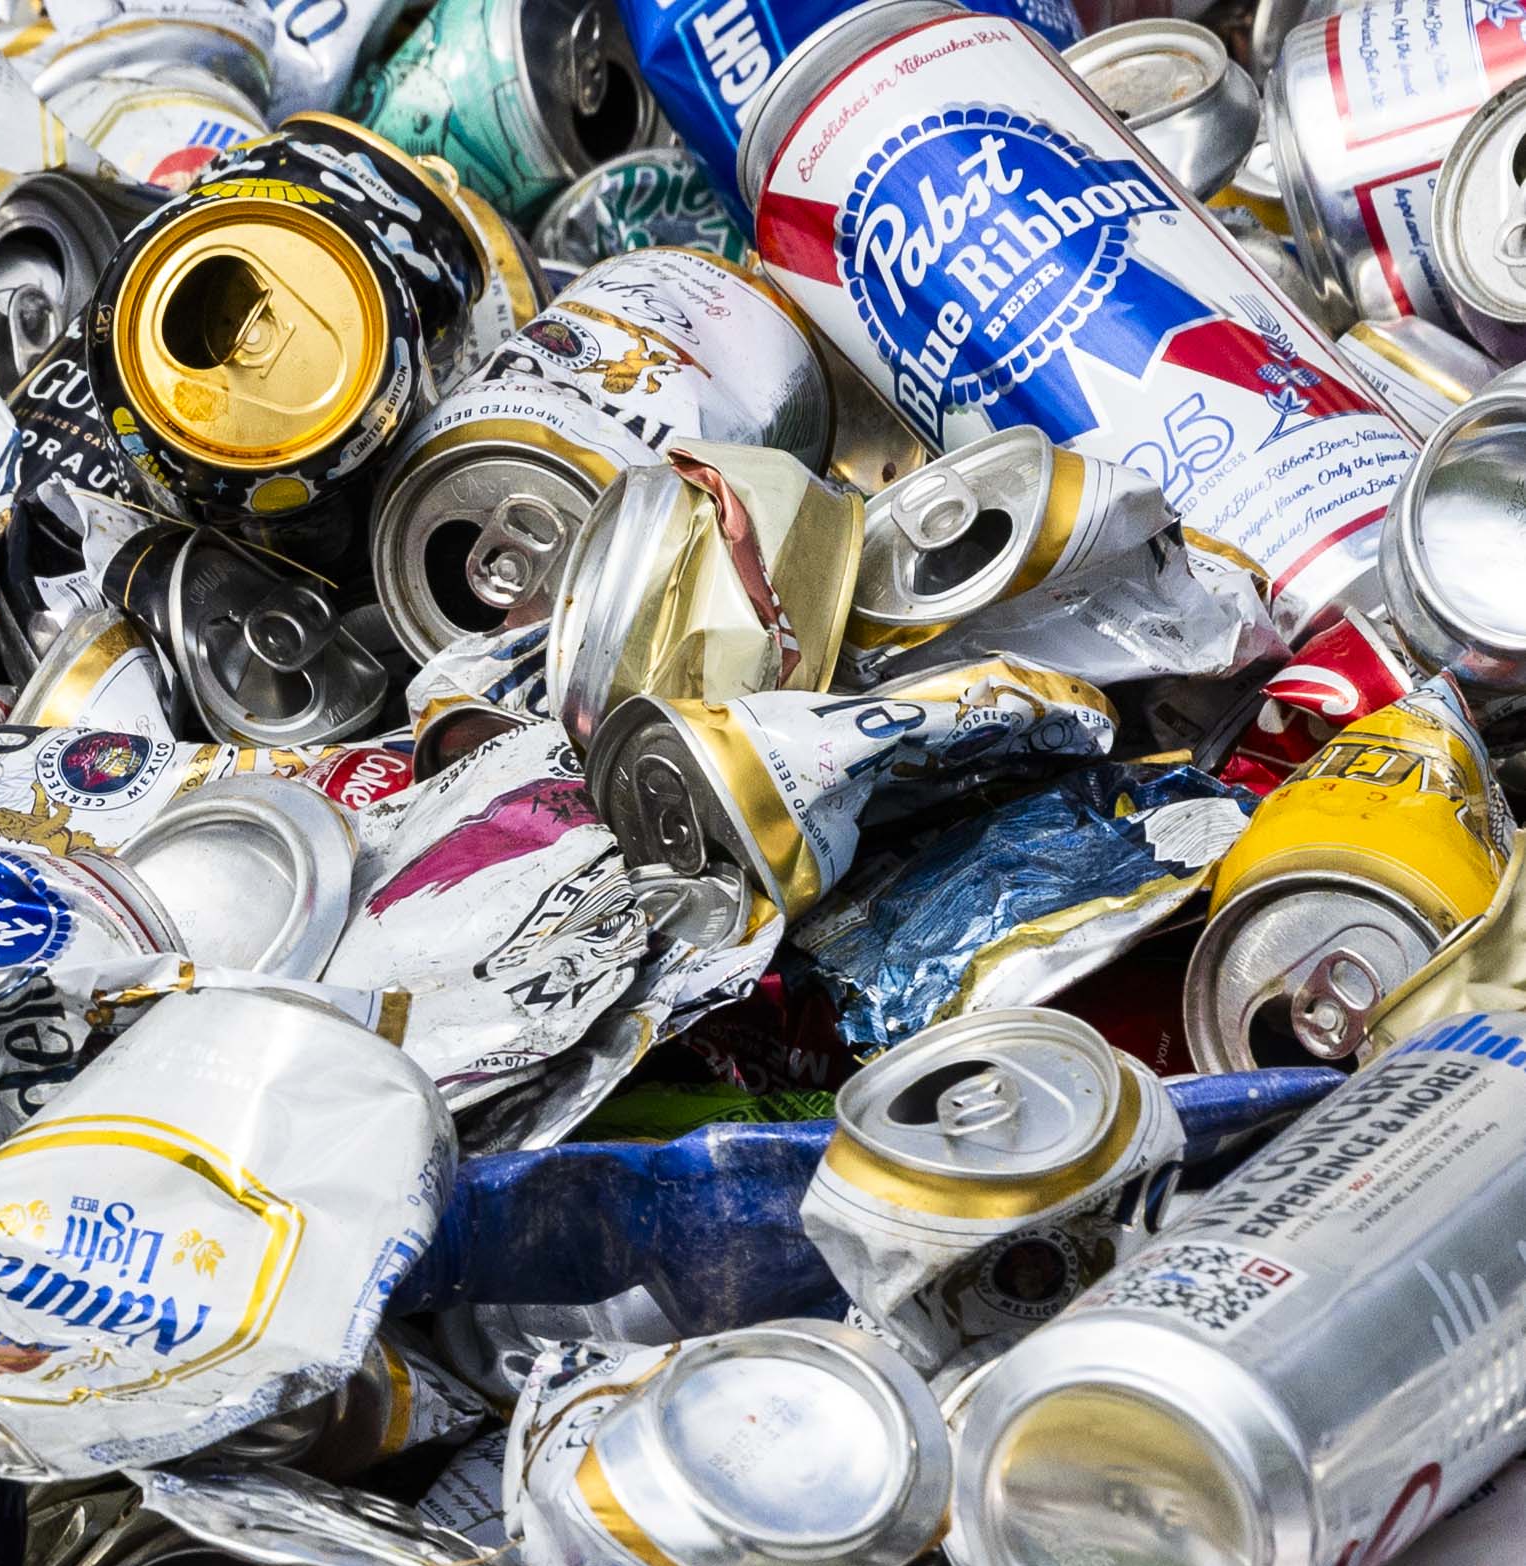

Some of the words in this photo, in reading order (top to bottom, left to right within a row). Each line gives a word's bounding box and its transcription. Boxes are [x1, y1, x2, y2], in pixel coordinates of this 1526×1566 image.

[856, 134, 1023, 316] Pabst
[894, 300, 973, 449] Blue
[946, 178, 1167, 313] Ribbon
[984, 262, 1064, 342] BEER
[351, 418, 387, 459] LIMITED
[384, 363, 408, 424] EDITION
[434, 406, 474, 434] BEER
[478, 403, 566, 435] IMPORTED
[1122, 392, 1234, 508] 25
[1200, 452, 1248, 497] OUNCES
[1264, 450, 1314, 489] Ribbon
[1315, 437, 1352, 460] Beer
[1318, 462, 1353, 487] Only
[1353, 453, 1375, 471] the
[1304, 482, 1368, 529] America's
[1366, 477, 1399, 497] Best
[46, 738, 107, 808] CERVECERIA
[127, 741, 171, 801] MEXICO
[343, 751, 408, 811] Coke
[768, 748, 795, 794] BEER
[787, 794, 831, 859] IMPORTED
[1235, 1127, 1388, 1242] EXPERIENCE
[1395, 1055, 1481, 1128] MORE!
[1246, 1057, 1429, 1187] CONCERT
[68, 1194, 100, 1212] BEER
[42, 1194, 166, 1285] Light
